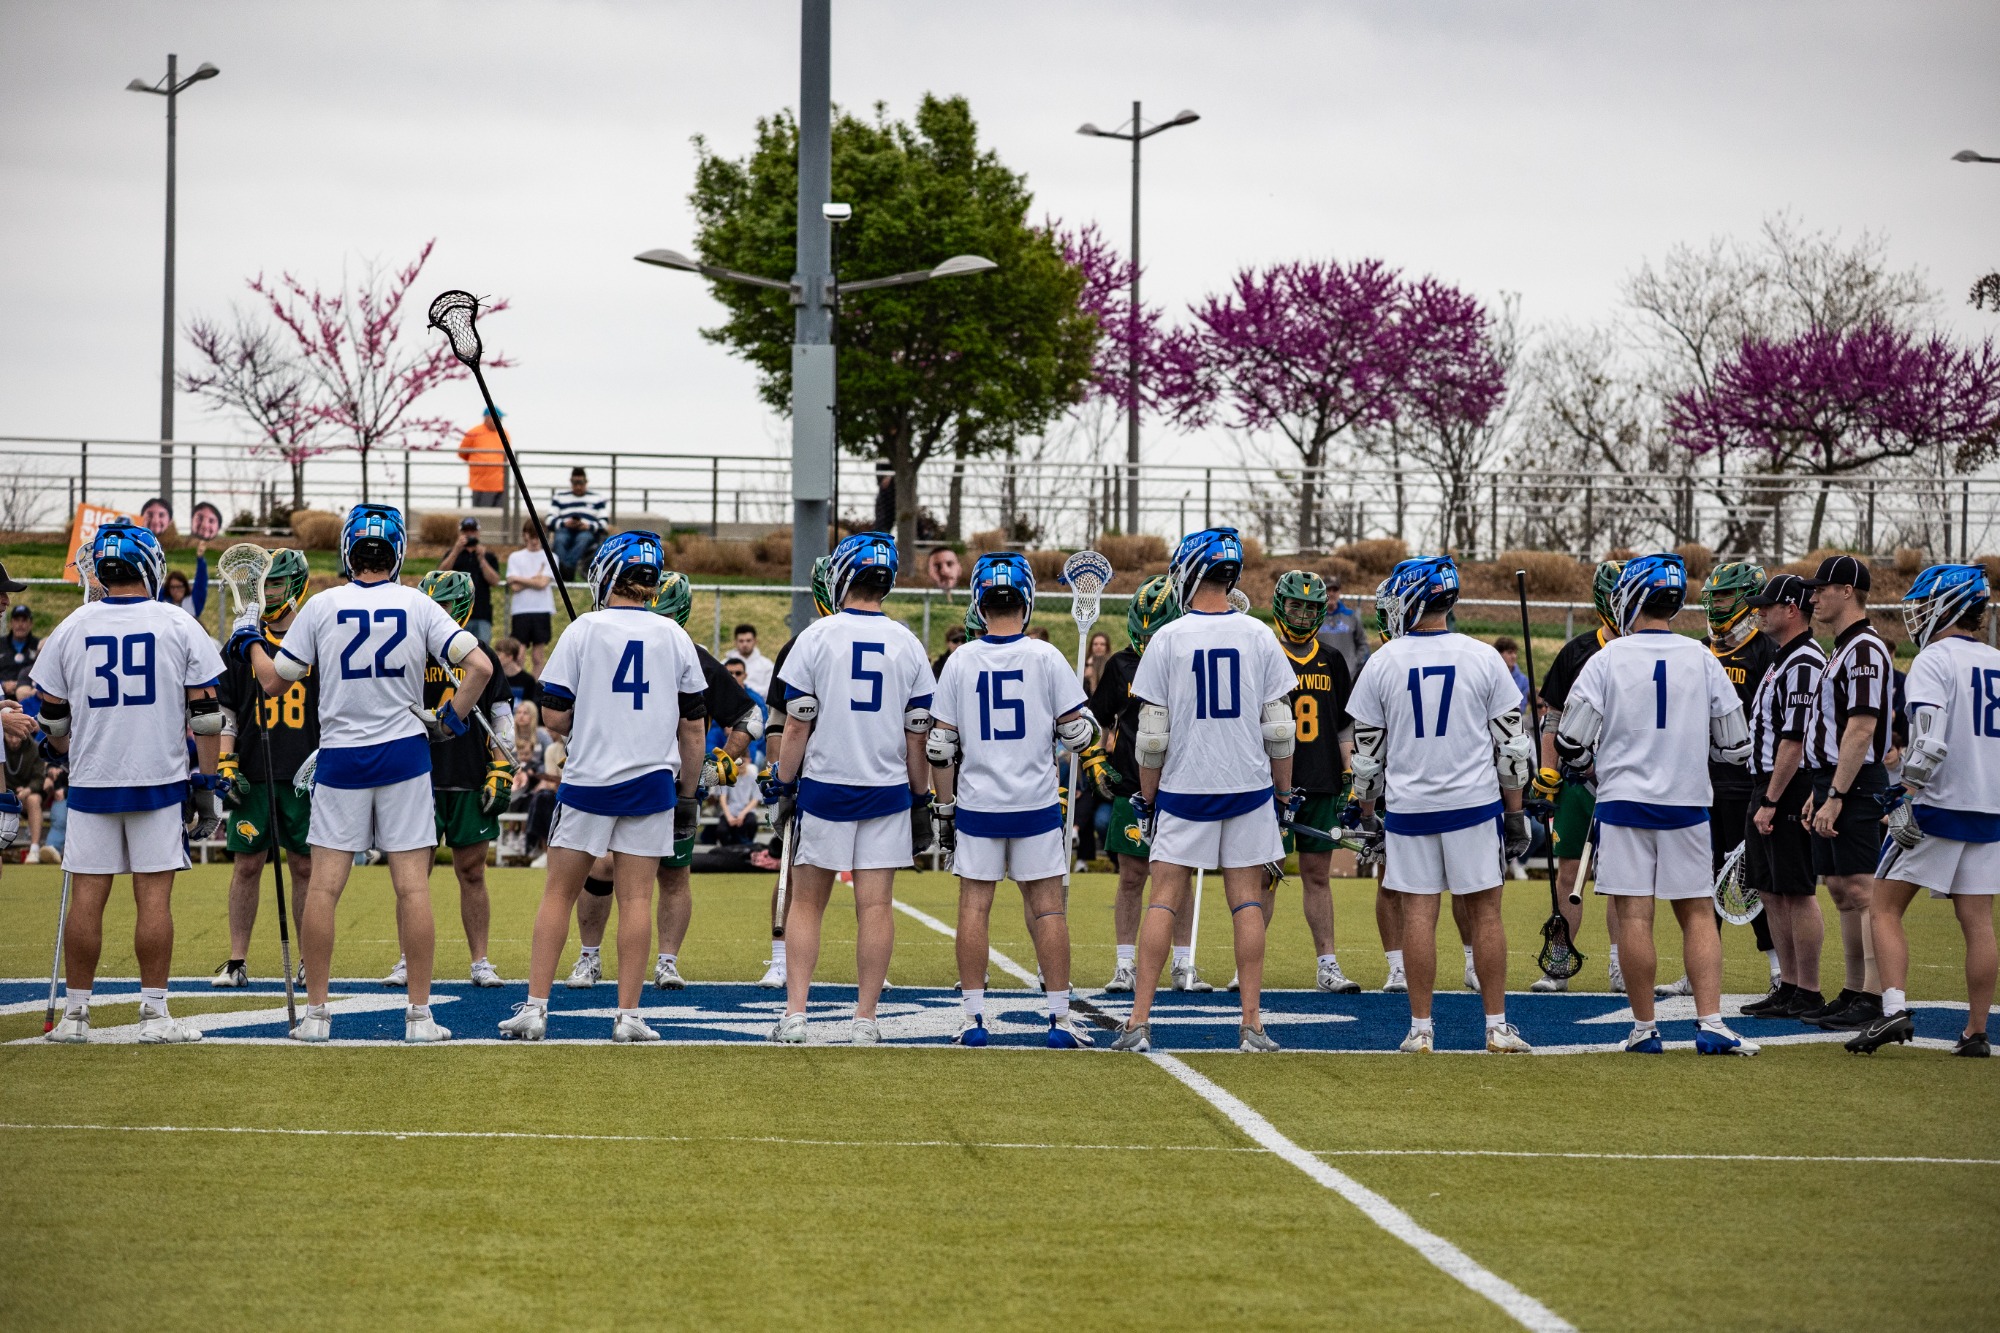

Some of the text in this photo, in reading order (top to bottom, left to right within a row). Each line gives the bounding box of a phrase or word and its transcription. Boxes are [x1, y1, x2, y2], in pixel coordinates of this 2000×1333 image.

[85, 632, 156, 708] 39
[337, 609, 408, 680] 22
[612, 640, 650, 710] 4
[851, 642, 885, 712] 5
[975, 669, 1026, 741] 15
[1192, 648, 1241, 719] 10
[1295, 695, 1319, 742] 8
[1407, 665, 1456, 738] 17
[1652, 660, 1667, 729] 1
[1971, 667, 2000, 738] 18
[911, 717, 929, 725] STX
